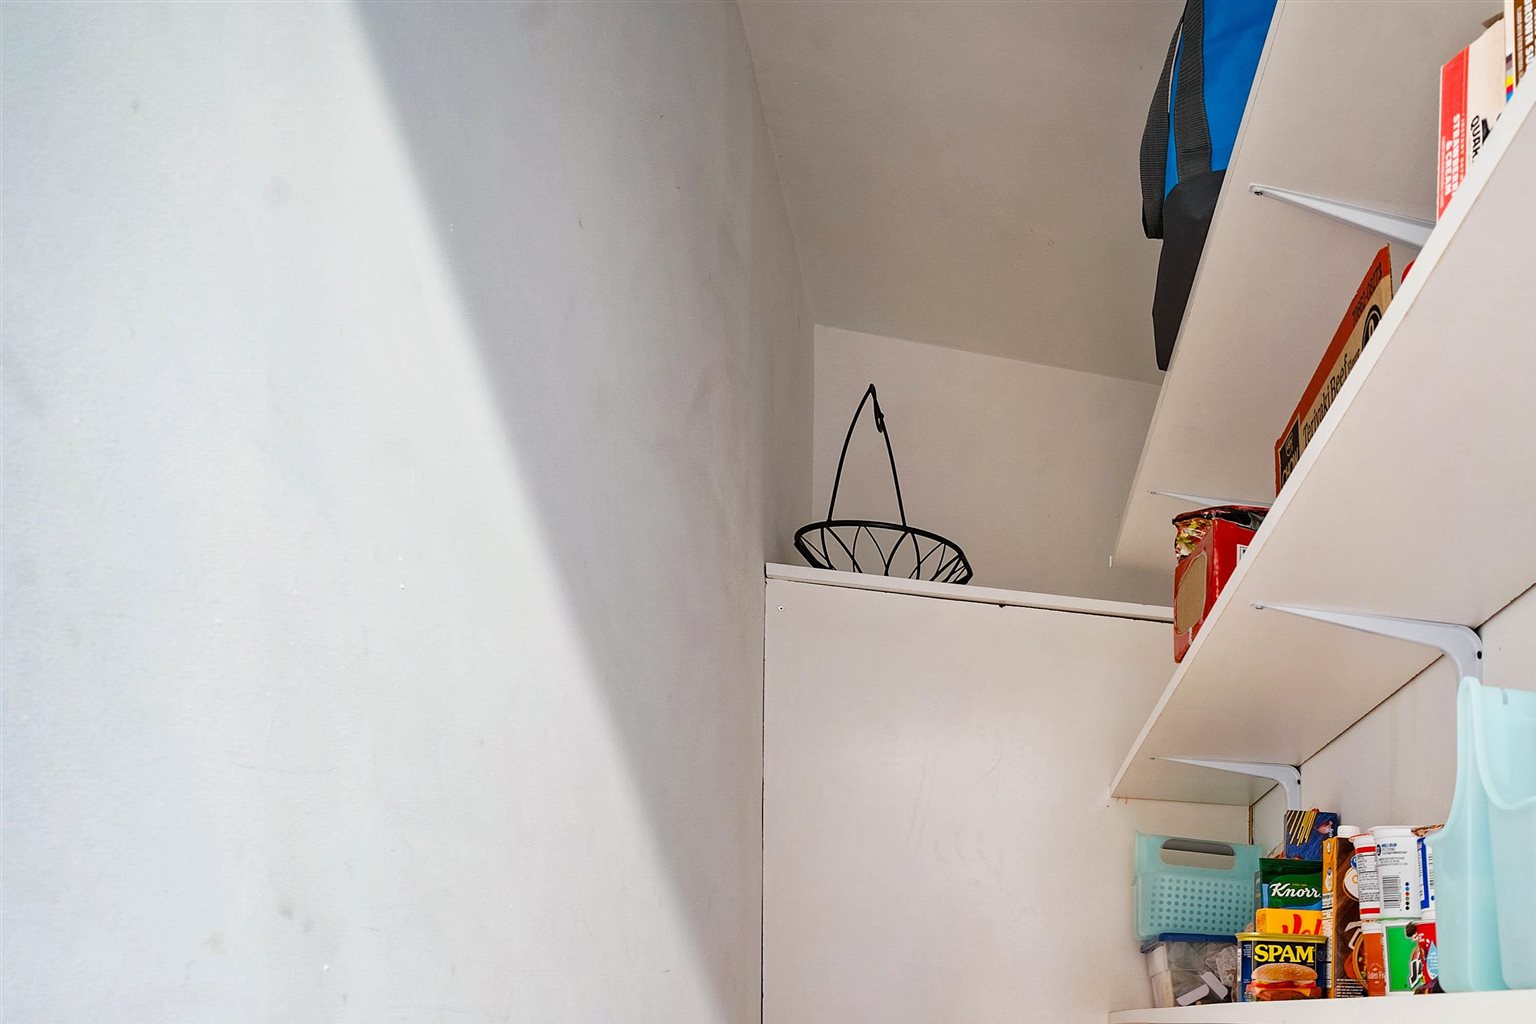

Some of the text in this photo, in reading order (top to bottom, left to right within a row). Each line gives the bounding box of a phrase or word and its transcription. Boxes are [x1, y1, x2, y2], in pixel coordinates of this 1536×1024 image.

[1330, 352, 1349, 401] Beef
[1269, 882, 1321, 898] Knorr
[1254, 943, 1315, 963] SPAM
